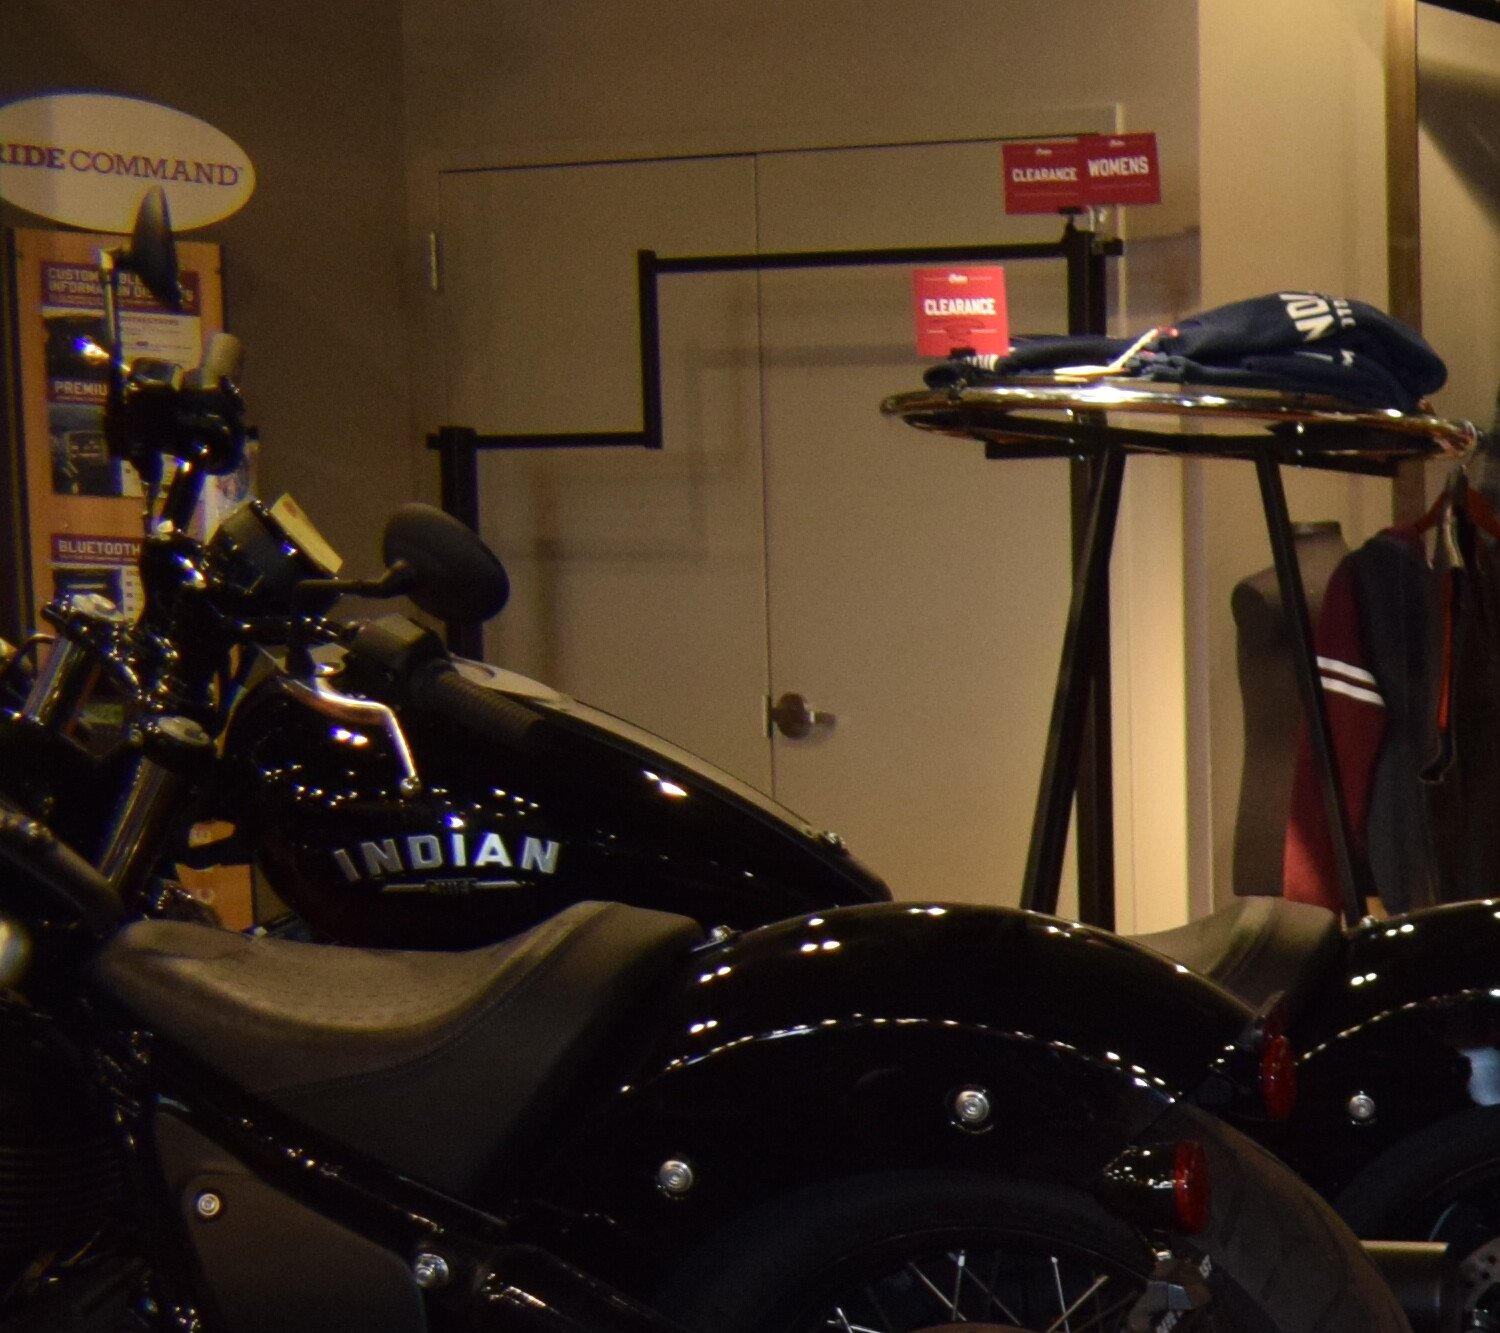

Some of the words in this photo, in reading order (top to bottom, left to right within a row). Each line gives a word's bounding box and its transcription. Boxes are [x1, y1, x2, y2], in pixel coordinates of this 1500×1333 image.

[69, 150, 240, 186] COMMAND
[1012, 167, 1078, 182] CLEARANCE
[1088, 156, 1150, 177] WOMENS
[923, 298, 997, 315] CLEARANCE
[59, 540, 141, 556] BLUETOOTH
[332, 831, 561, 883] INDIAN
